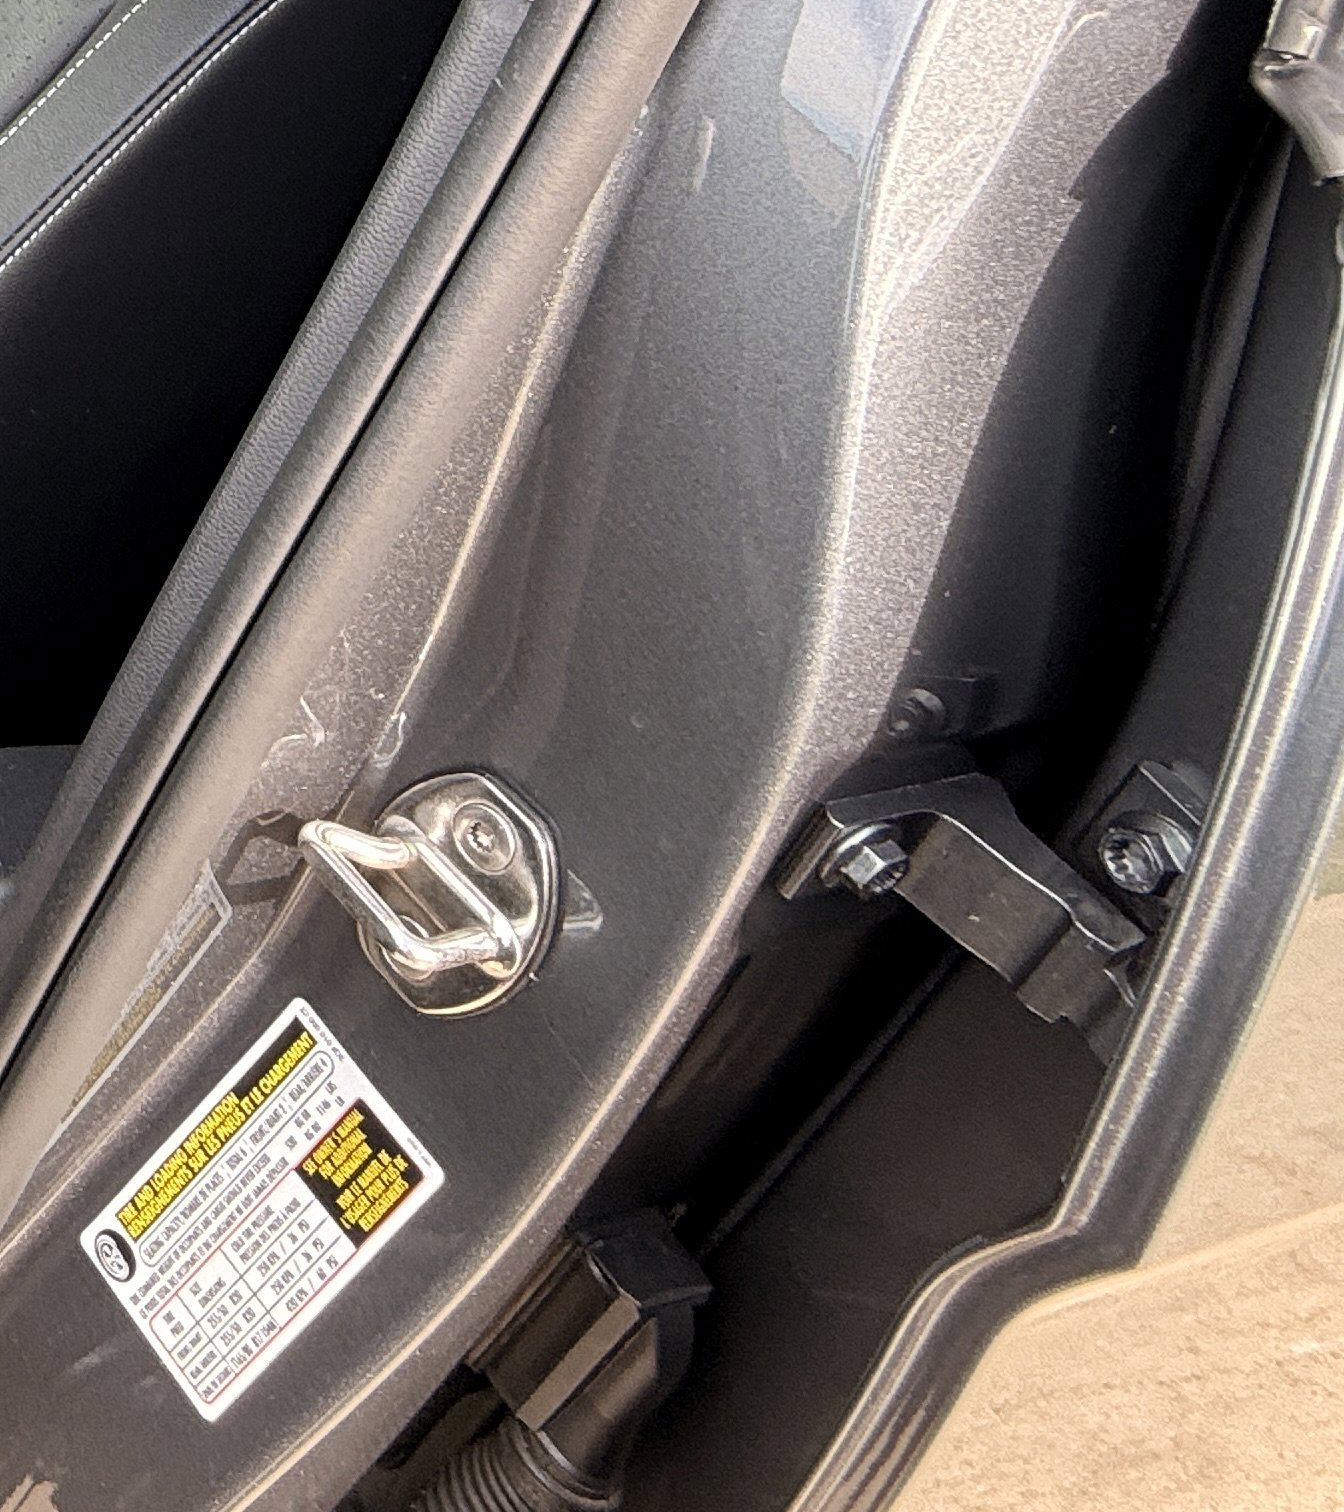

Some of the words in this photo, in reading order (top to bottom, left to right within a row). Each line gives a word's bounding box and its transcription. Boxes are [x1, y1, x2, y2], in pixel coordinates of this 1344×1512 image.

[117, 1201, 138, 1227] TIRE
[132, 1182, 155, 1210] AND
[149, 1146, 188, 1192] LOADING
[182, 1090, 240, 1155] INFORMATION
[186, 1146, 208, 1173] SUR
[201, 1132, 222, 1156] LES
[214, 1106, 246, 1143] PNEUS
[239, 1095, 256, 1115] ET
[248, 1085, 265, 1105] LE
[257, 1031, 315, 1095] CHARGEMENT
